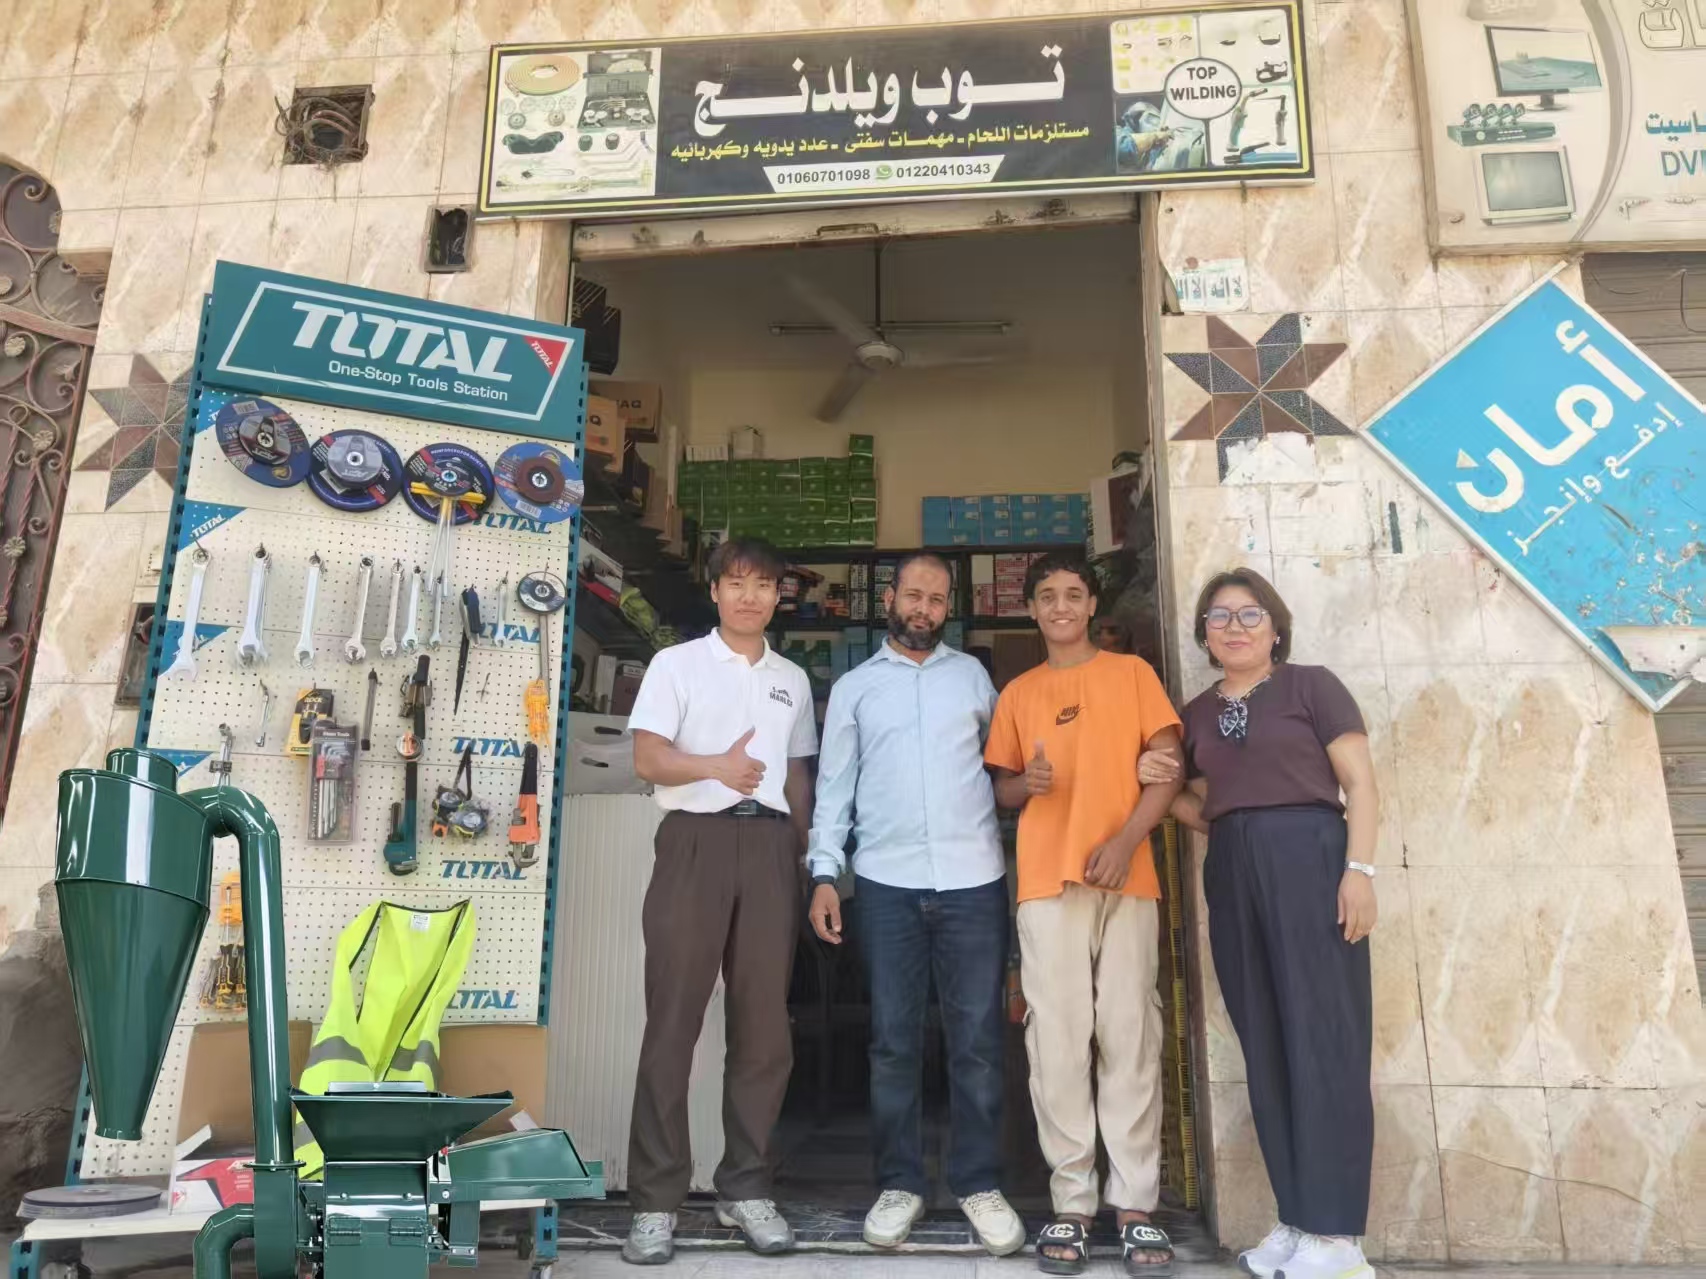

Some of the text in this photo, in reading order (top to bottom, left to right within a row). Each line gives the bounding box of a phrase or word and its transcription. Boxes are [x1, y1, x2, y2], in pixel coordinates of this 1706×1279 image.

[1187, 67, 1217, 80] TOP
[694, 44, 1065, 137] توب ويلدنج
[1170, 85, 1237, 100] WILDING
[888, 130, 954, 149] مهمات
[967, 127, 1010, 149] اللحام
[1013, 122, 1090, 144] مستلزمات
[798, 137, 828, 152] عدد
[777, 164, 991, 185] 01060701098 01220410343
[292, 300, 513, 383] TOTAL
[530, 340, 553, 368] TOTAL
[328, 360, 508, 401] One-Stop Tools Station
[1455, 319, 1647, 513] أمان
